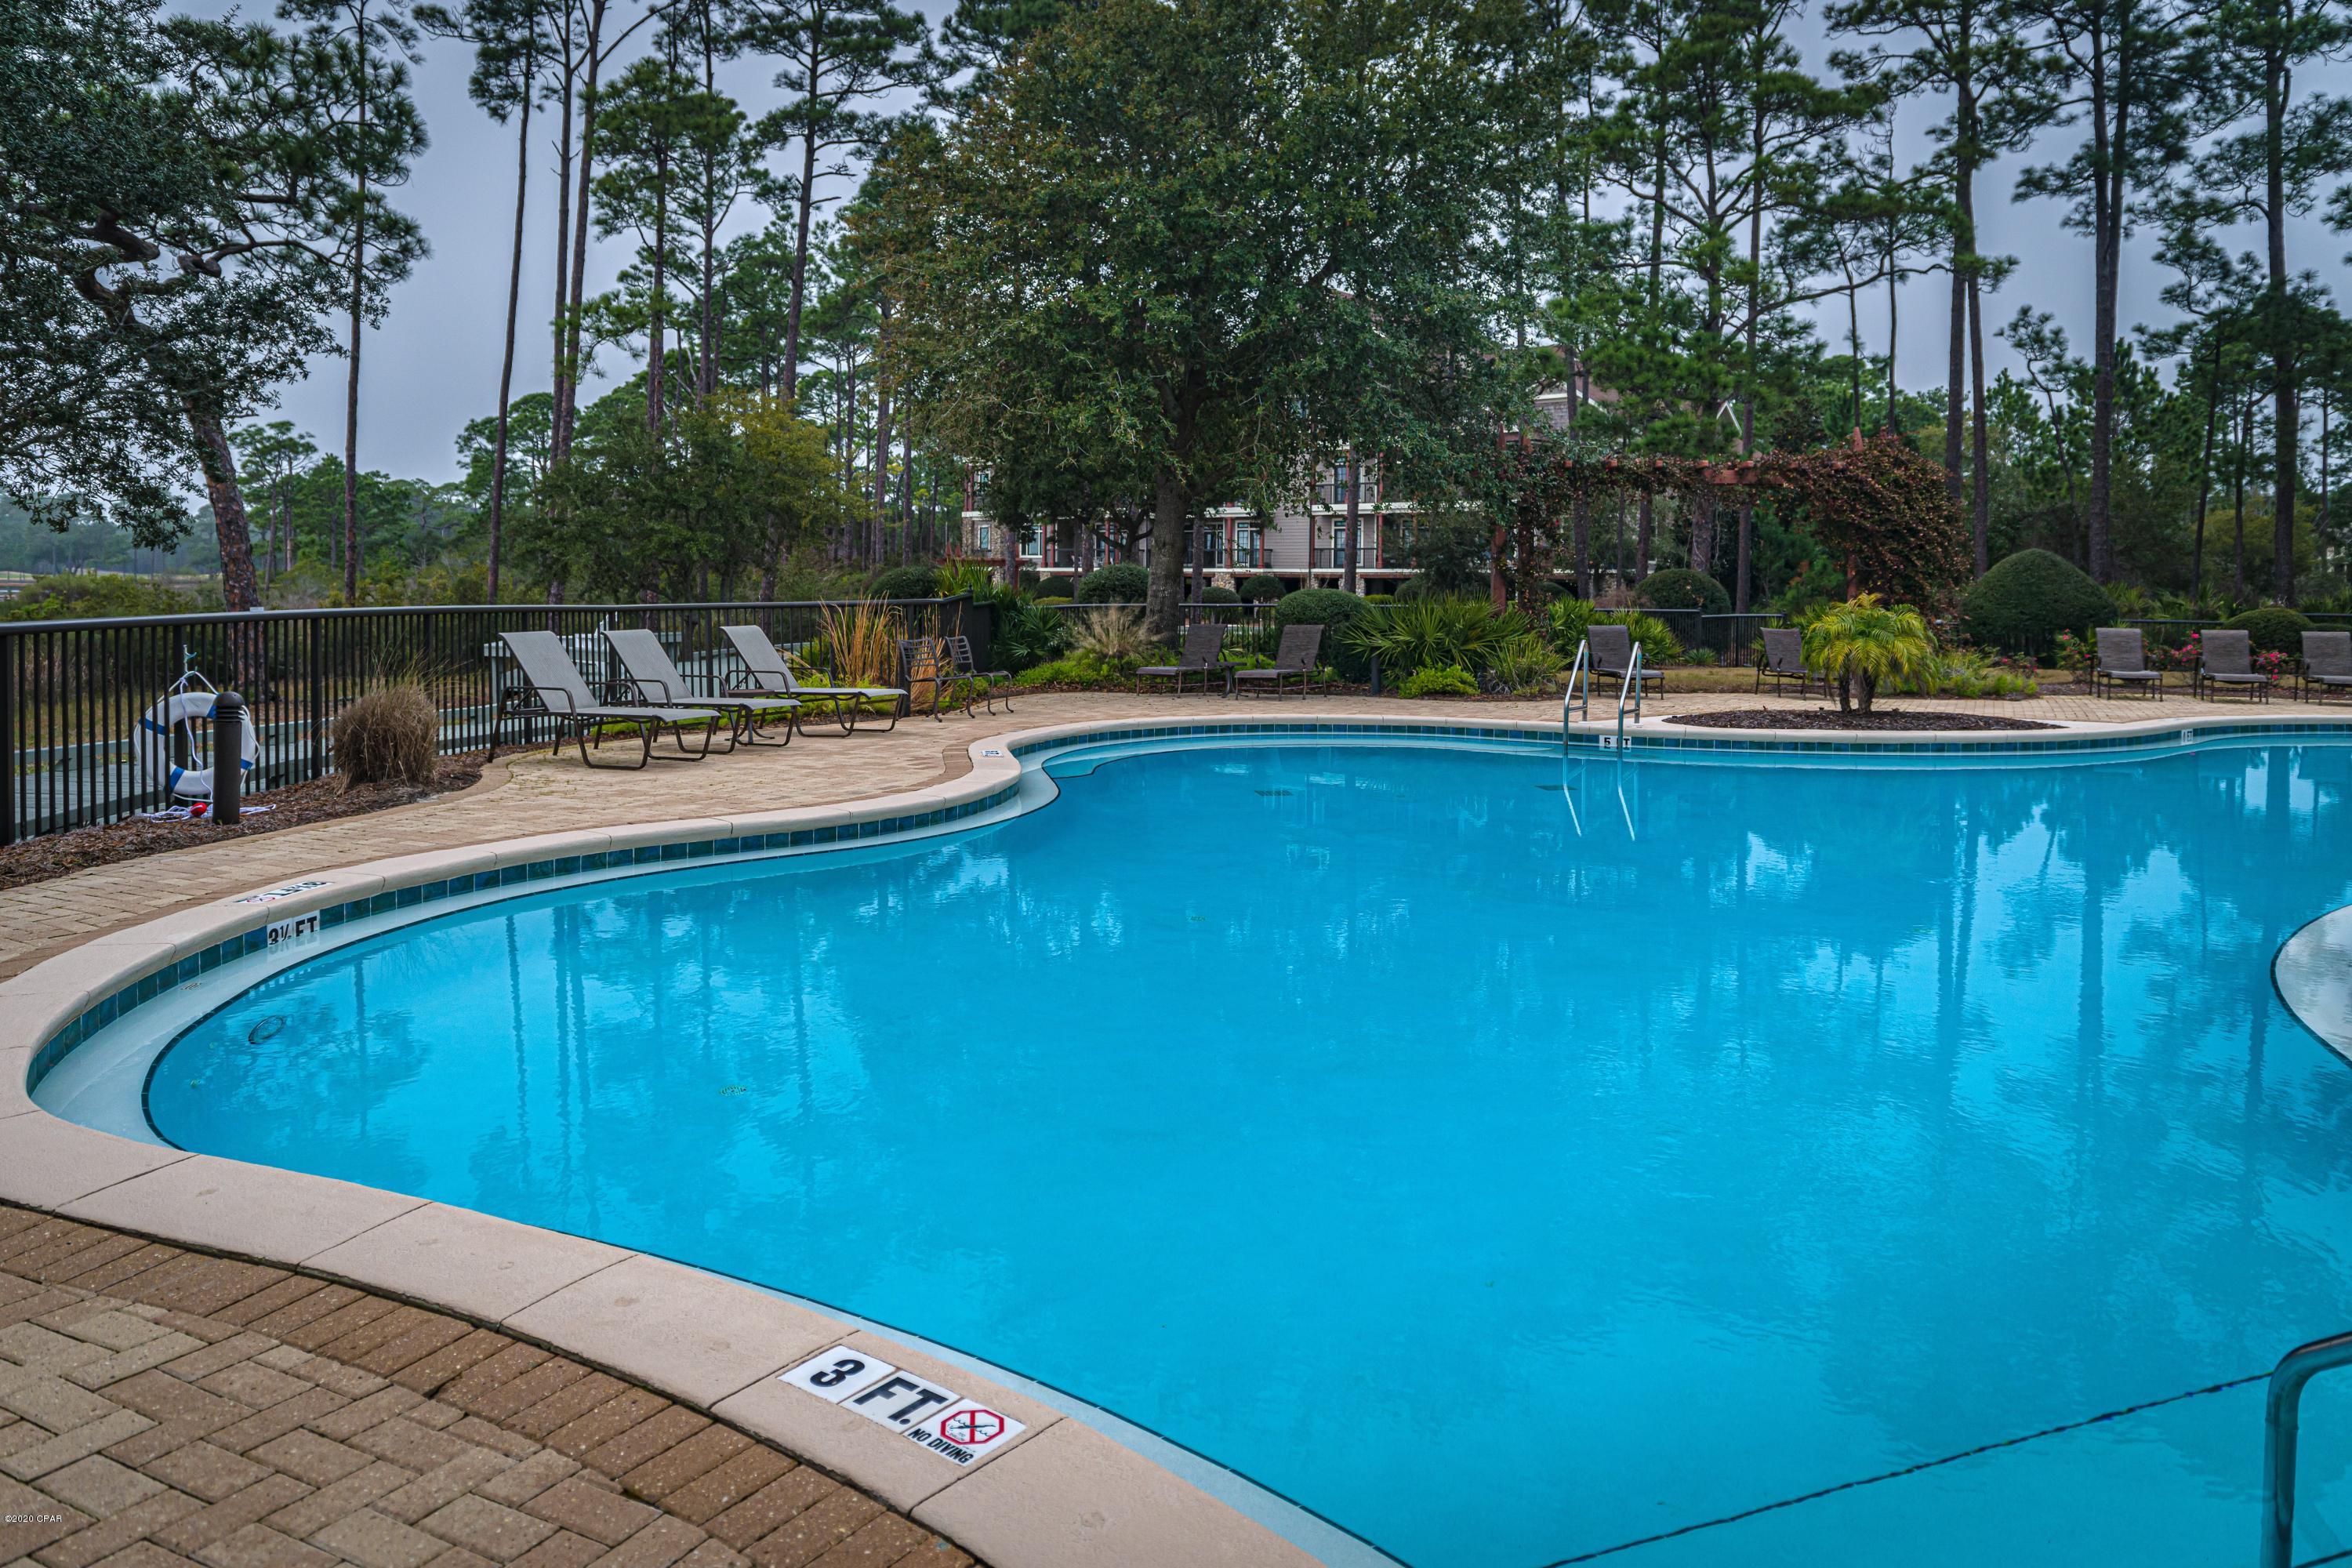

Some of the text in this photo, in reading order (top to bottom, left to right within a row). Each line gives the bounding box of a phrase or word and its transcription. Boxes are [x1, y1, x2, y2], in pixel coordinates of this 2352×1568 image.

[1604, 737, 1611, 746] 5
[809, 1359, 949, 1425] 3 FT.
[907, 1428, 975, 1465] NO DIVING
